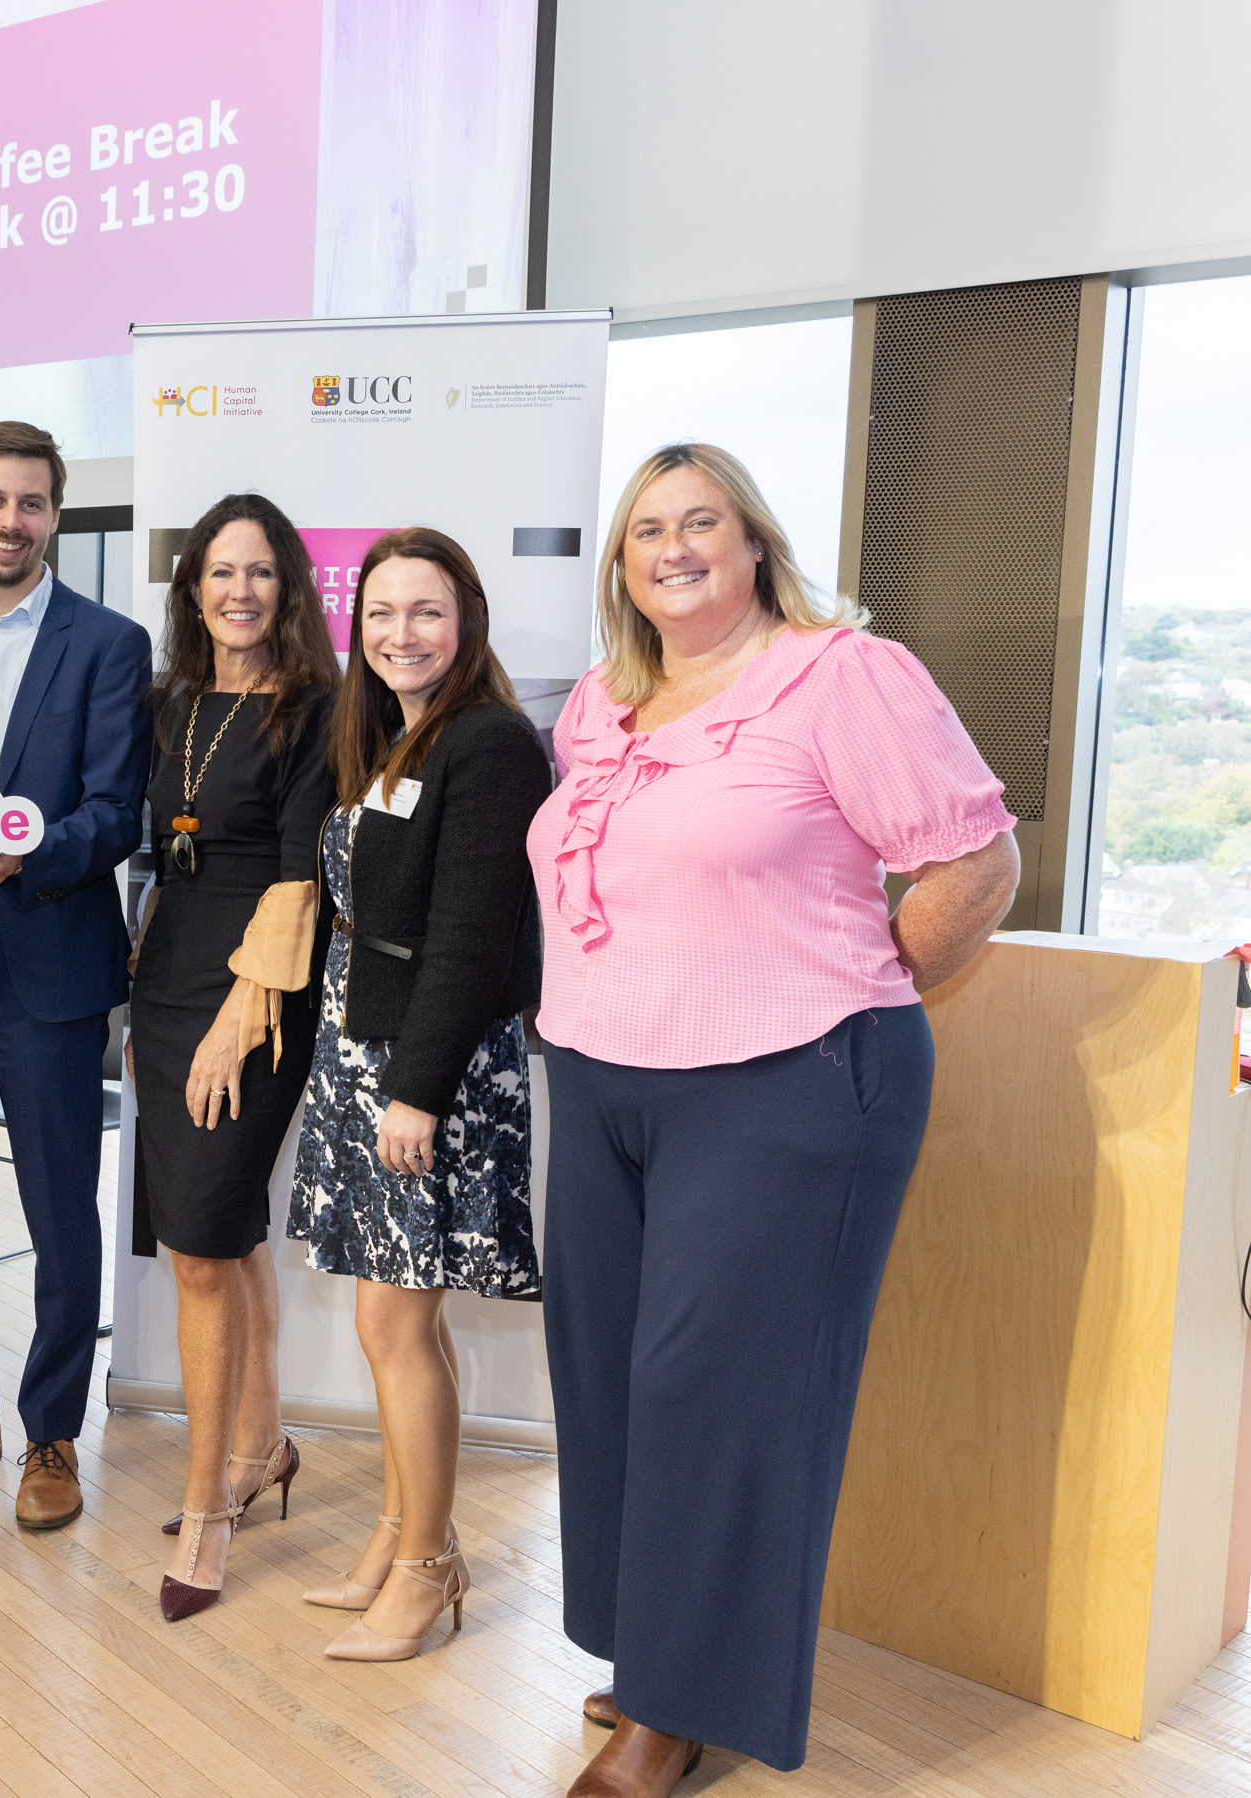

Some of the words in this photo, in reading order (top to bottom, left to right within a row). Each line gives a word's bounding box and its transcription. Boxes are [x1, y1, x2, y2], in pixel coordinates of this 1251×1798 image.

[90, 99, 239, 172] Break
[41, 195, 78, 246] @
[99, 164, 246, 232] 11:30
[224, 386, 257, 394] Human
[346, 375, 412, 405] UCC
[151, 385, 218, 417] HCI
[224, 396, 256, 406] Capital
[223, 408, 263, 416] Initiative
[381, 416, 412, 424] Corcaigh
